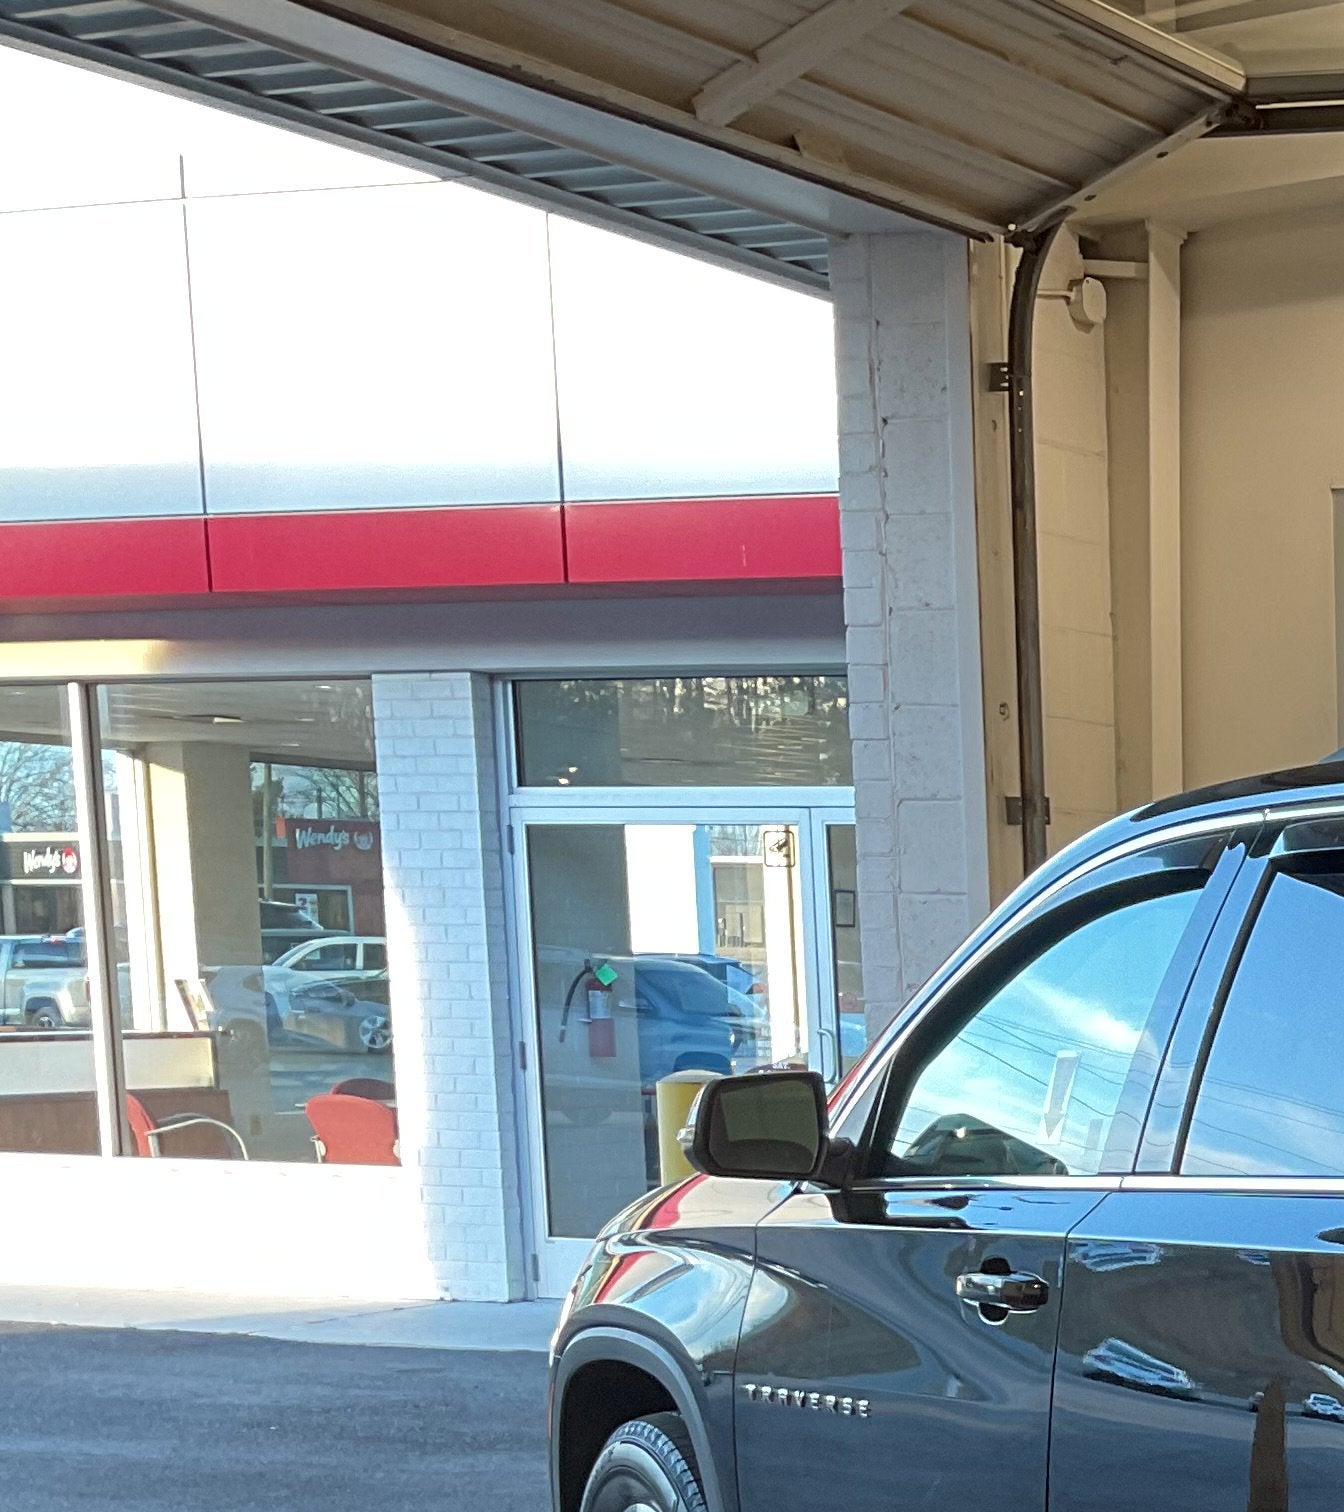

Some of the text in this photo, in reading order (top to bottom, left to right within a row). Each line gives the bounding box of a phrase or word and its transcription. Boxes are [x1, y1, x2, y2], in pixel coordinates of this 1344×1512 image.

[295, 825, 349, 850] Wendy's
[23, 847, 60, 874] Wendy's
[744, 1383, 870, 1418] TRAVERSE
